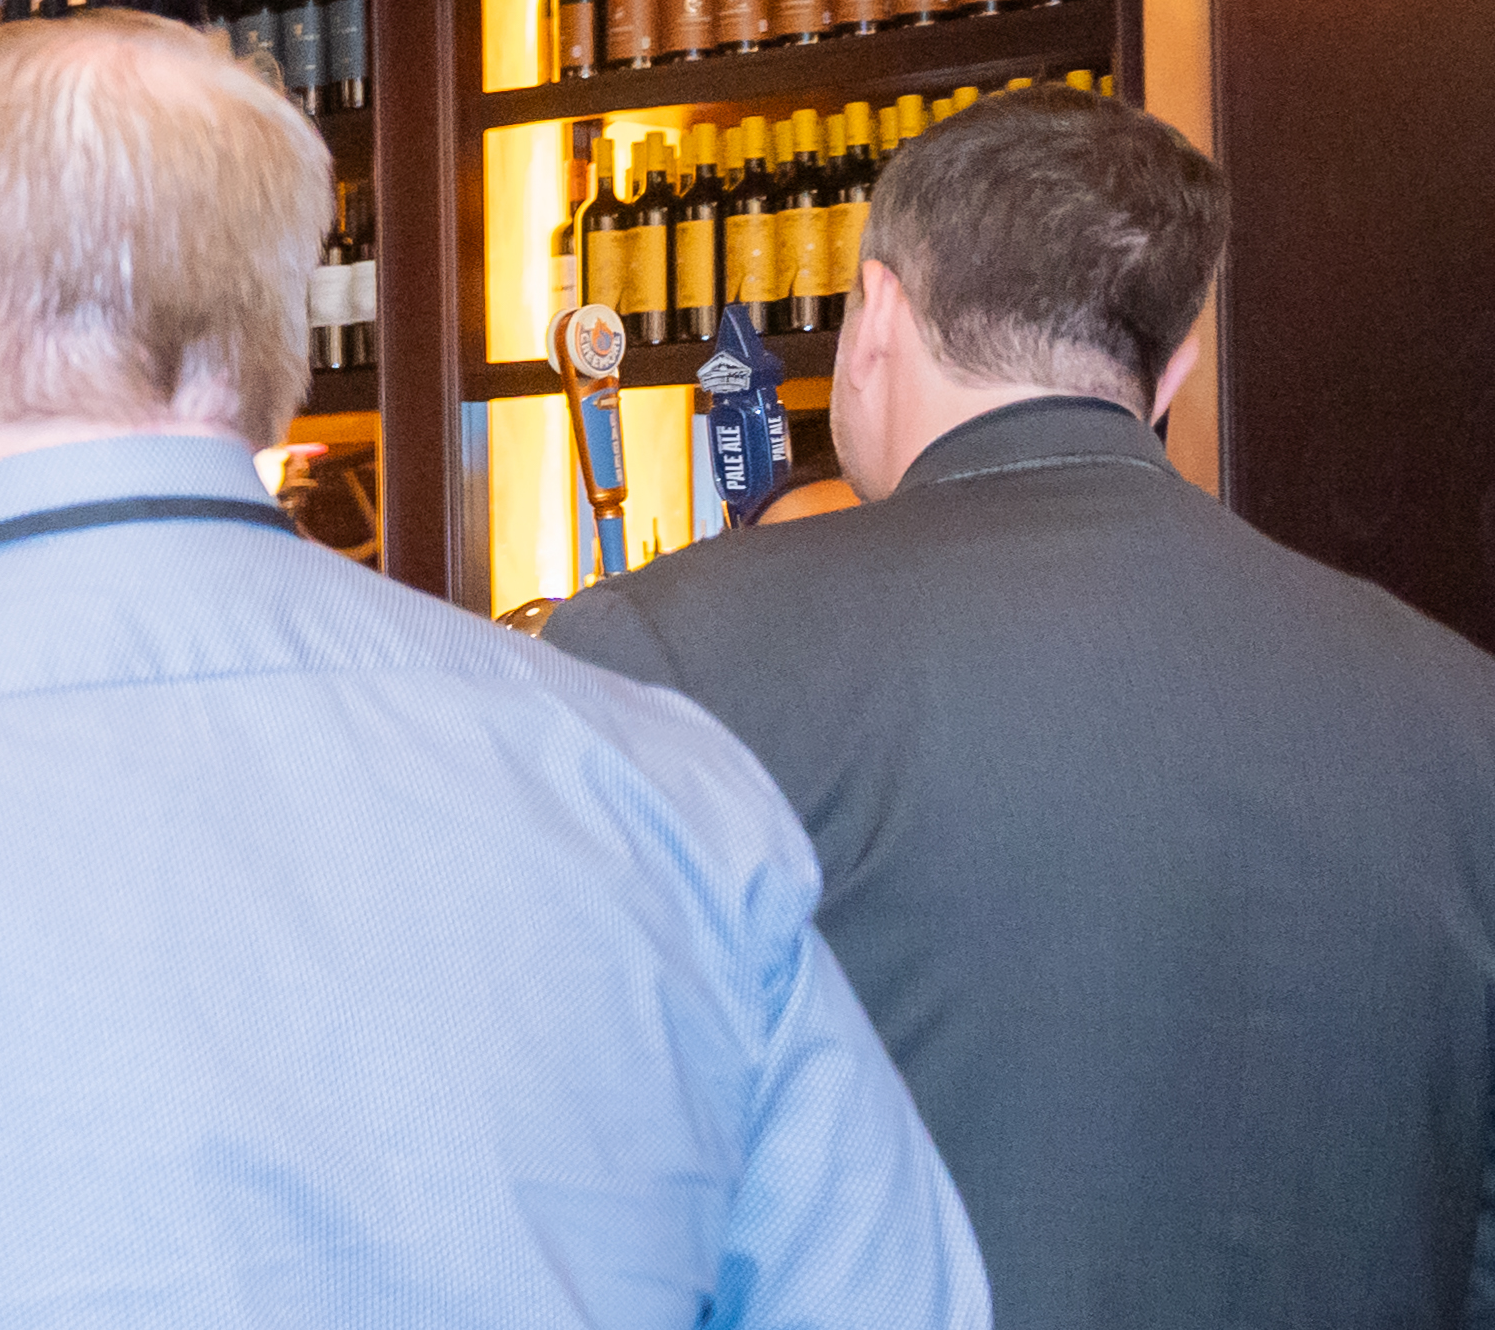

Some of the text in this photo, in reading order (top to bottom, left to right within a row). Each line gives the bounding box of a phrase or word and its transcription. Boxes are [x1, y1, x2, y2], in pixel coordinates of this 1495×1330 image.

[722, 425, 747, 490] PALE ALE
[768, 415, 787, 462] PALE ALE
